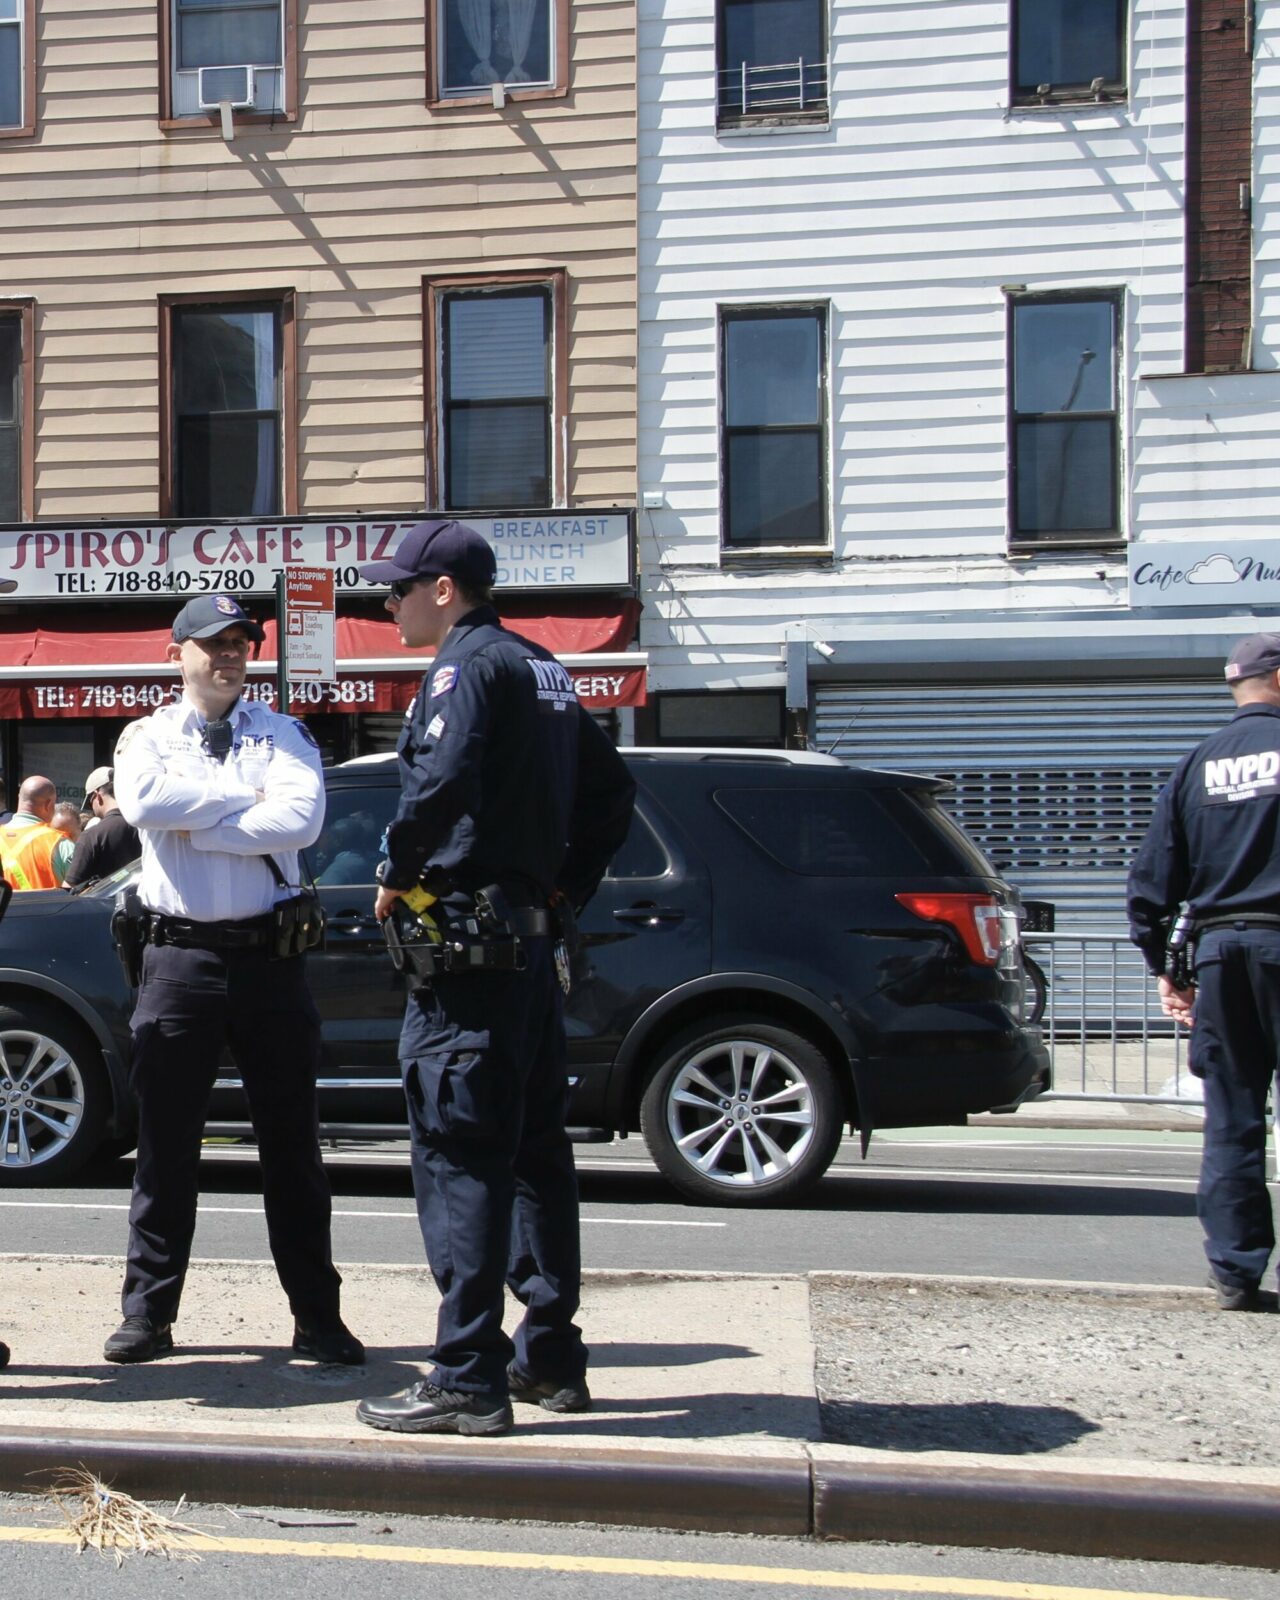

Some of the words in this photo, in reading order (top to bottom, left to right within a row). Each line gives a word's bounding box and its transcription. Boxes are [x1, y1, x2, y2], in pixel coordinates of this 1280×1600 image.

[493, 519, 608, 538] BREAKFAST
[9, 528, 177, 569] SPIRO'S
[193, 526, 305, 566] CAFE
[494, 543, 585, 561] LUNCH
[55, 572, 95, 593] TEL:
[104, 568, 255, 592] 718-840-5780
[288, 571, 297, 580] NO
[298, 571, 326, 581] STOPPING
[288, 582, 313, 591] Anytime
[495, 566, 576, 583] DINER
[1133, 562, 1186, 591] Cafe
[526, 659, 573, 691] NYPD
[34, 686, 74, 708] TEL:
[81, 684, 185, 708] 718-840-5
[1204, 751, 1279, 788] NYPD
